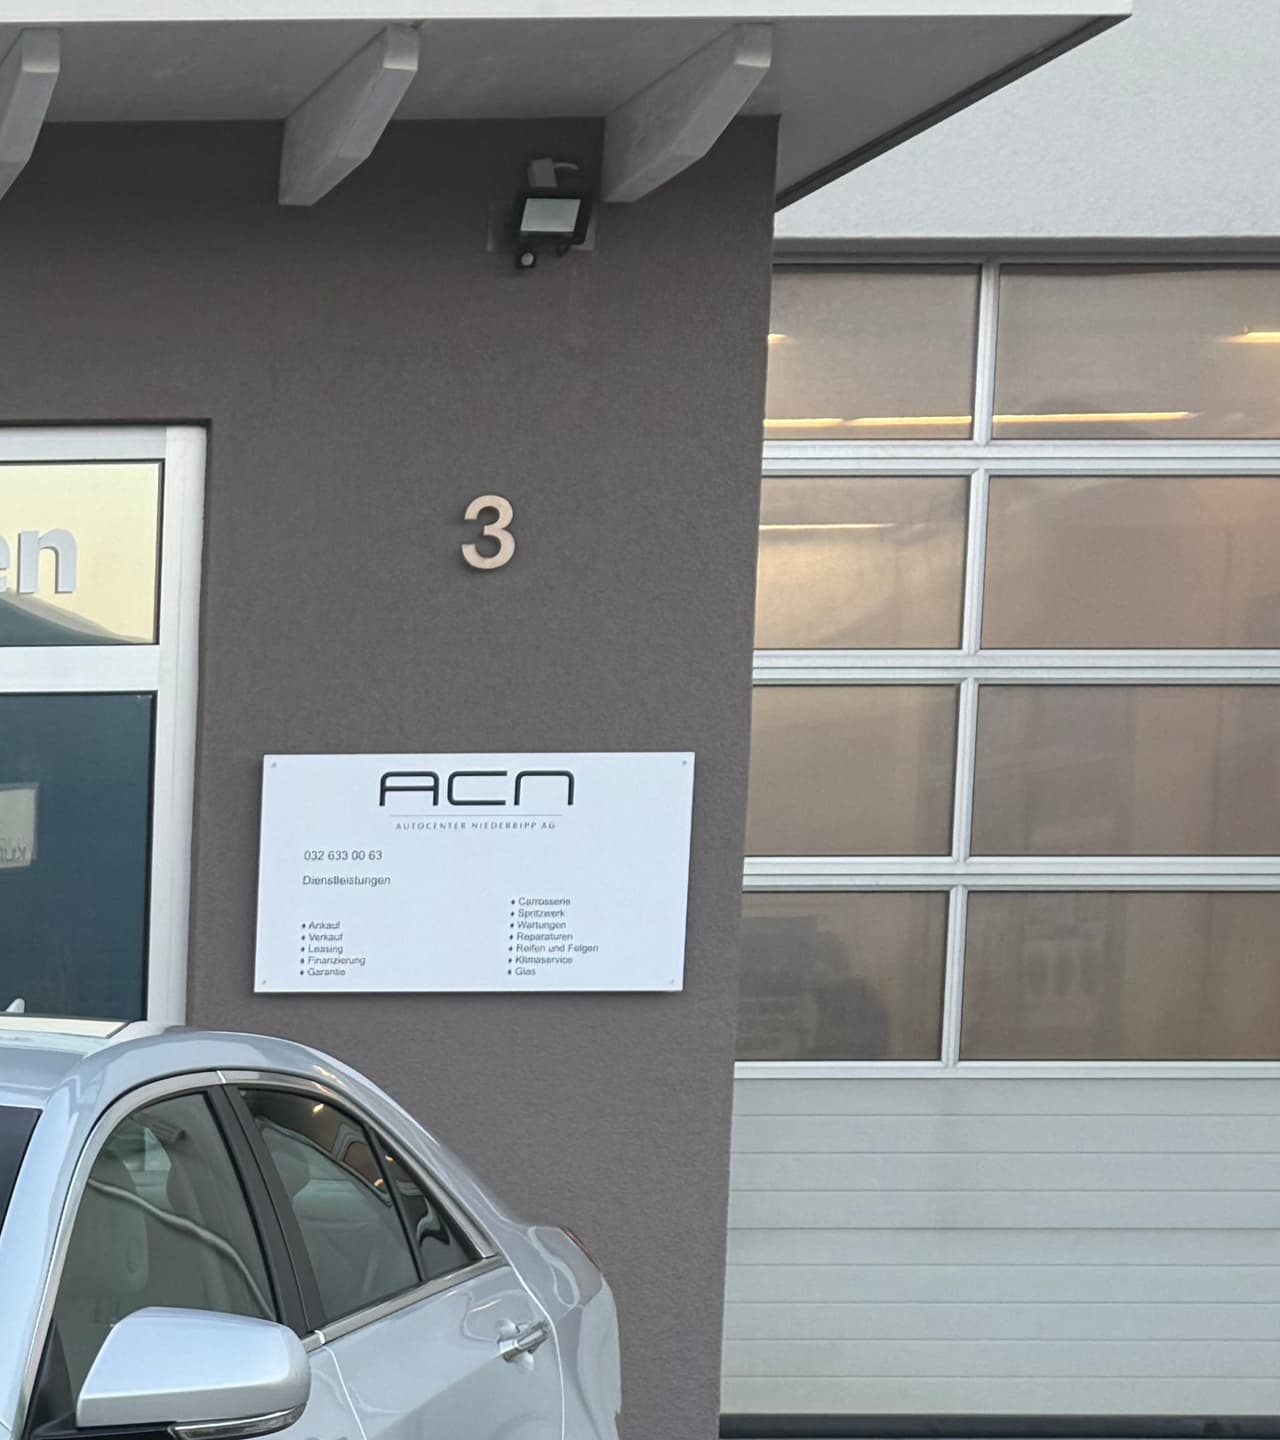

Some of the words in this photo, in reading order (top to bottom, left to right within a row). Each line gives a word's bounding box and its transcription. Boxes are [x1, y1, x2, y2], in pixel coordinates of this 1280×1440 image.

[461, 494, 516, 570] 3
[379, 770, 575, 806] ACN
[395, 821, 467, 831] AUTOCENTER
[471, 821, 537, 830] NIEDERBIPP
[540, 821, 556, 830] AG
[303, 850, 325, 861] 032
[327, 849, 349, 861] 633
[351, 849, 366, 861] 00
[367, 849, 383, 861] 63
[302, 875, 391, 888] Dienstleistungen
[307, 920, 341, 930] Ankauf
[516, 920, 567, 932] Wartungen
[308, 932, 344, 942] Verkauf
[516, 931, 574, 942] Reparaturen
